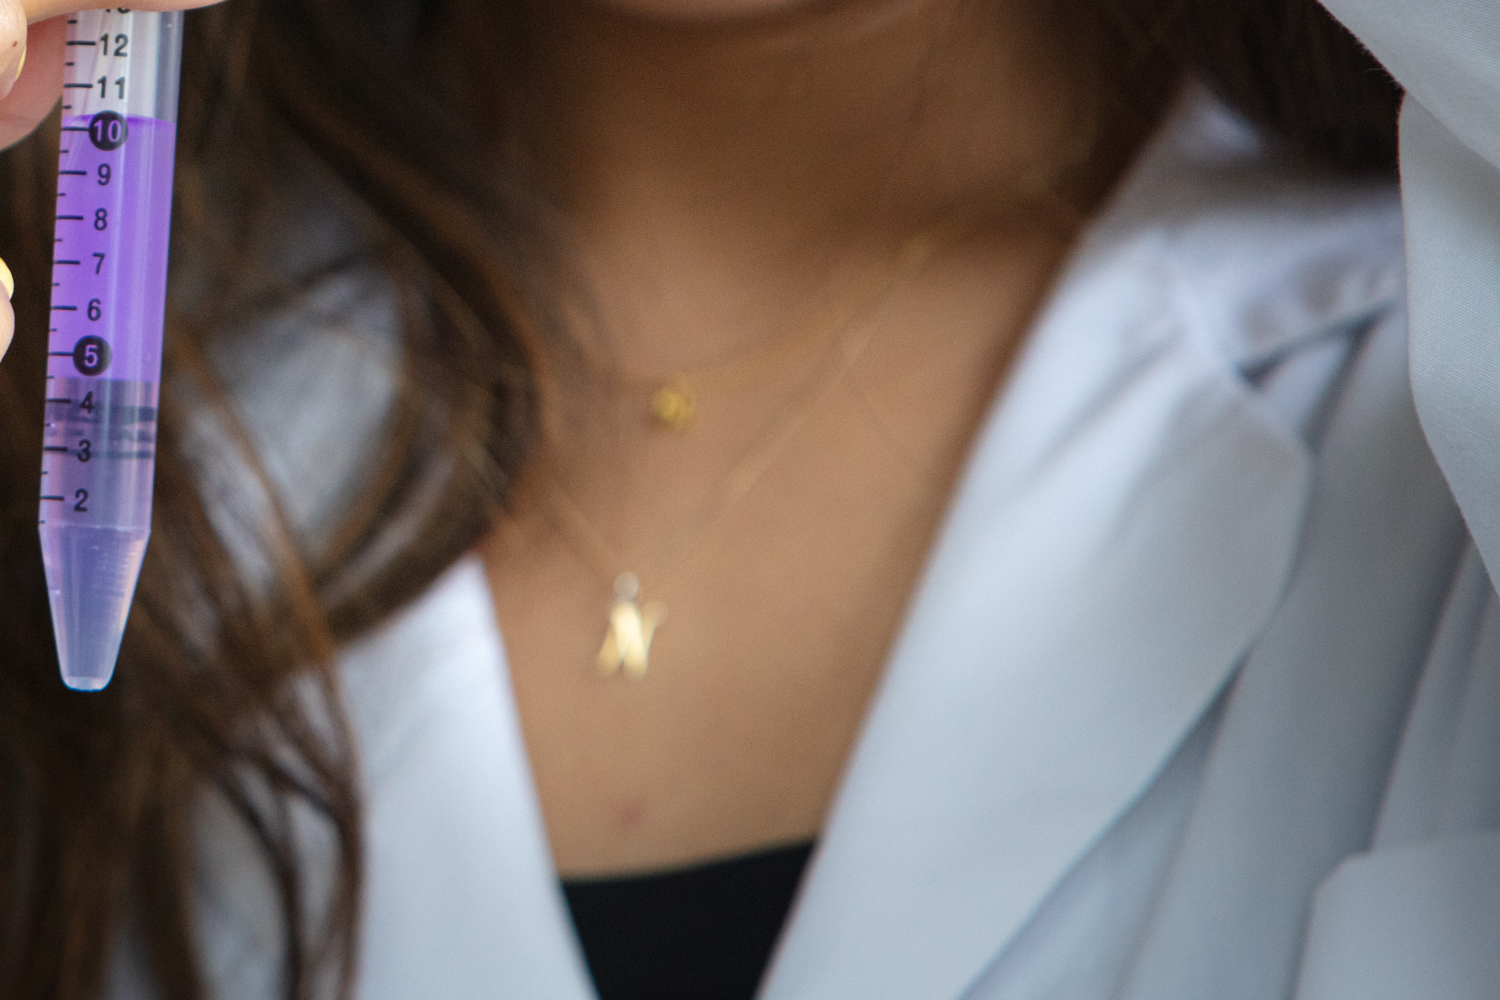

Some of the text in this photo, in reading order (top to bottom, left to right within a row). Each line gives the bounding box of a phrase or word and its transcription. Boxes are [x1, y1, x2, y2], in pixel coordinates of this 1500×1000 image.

[100, 32, 129, 57] 12
[97, 75, 126, 100] 11
[93, 119, 122, 142] 10
[97, 163, 112, 186] 9
[93, 207, 108, 231] 8
[92, 252, 106, 275] 7
[87, 298, 102, 321] 6
[84, 344, 99, 368] 5
[80, 391, 95, 414] 4
[77, 439, 92, 462] 3
[74, 488, 89, 512] 2
